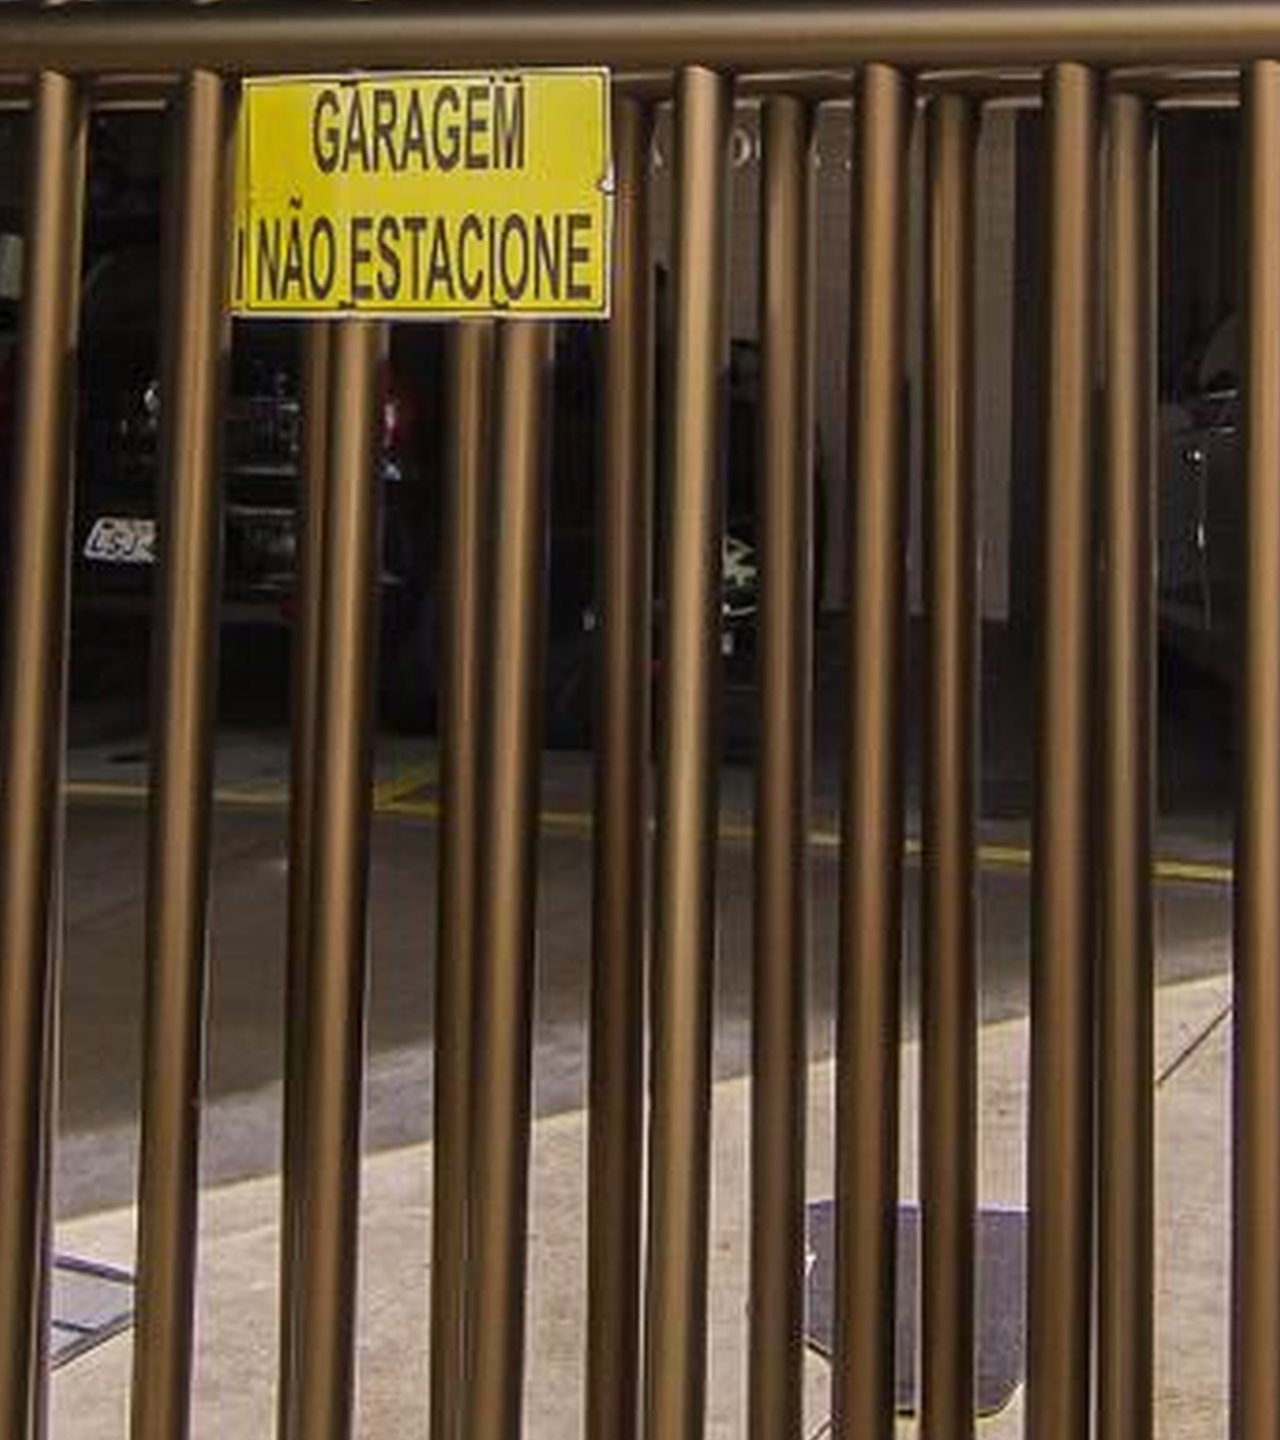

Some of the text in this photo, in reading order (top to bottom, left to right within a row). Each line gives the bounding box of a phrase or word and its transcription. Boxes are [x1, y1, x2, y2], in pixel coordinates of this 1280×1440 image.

[312, 85, 525, 173] GARAGEM
[256, 197, 593, 301] NÃO ESTACIONE
